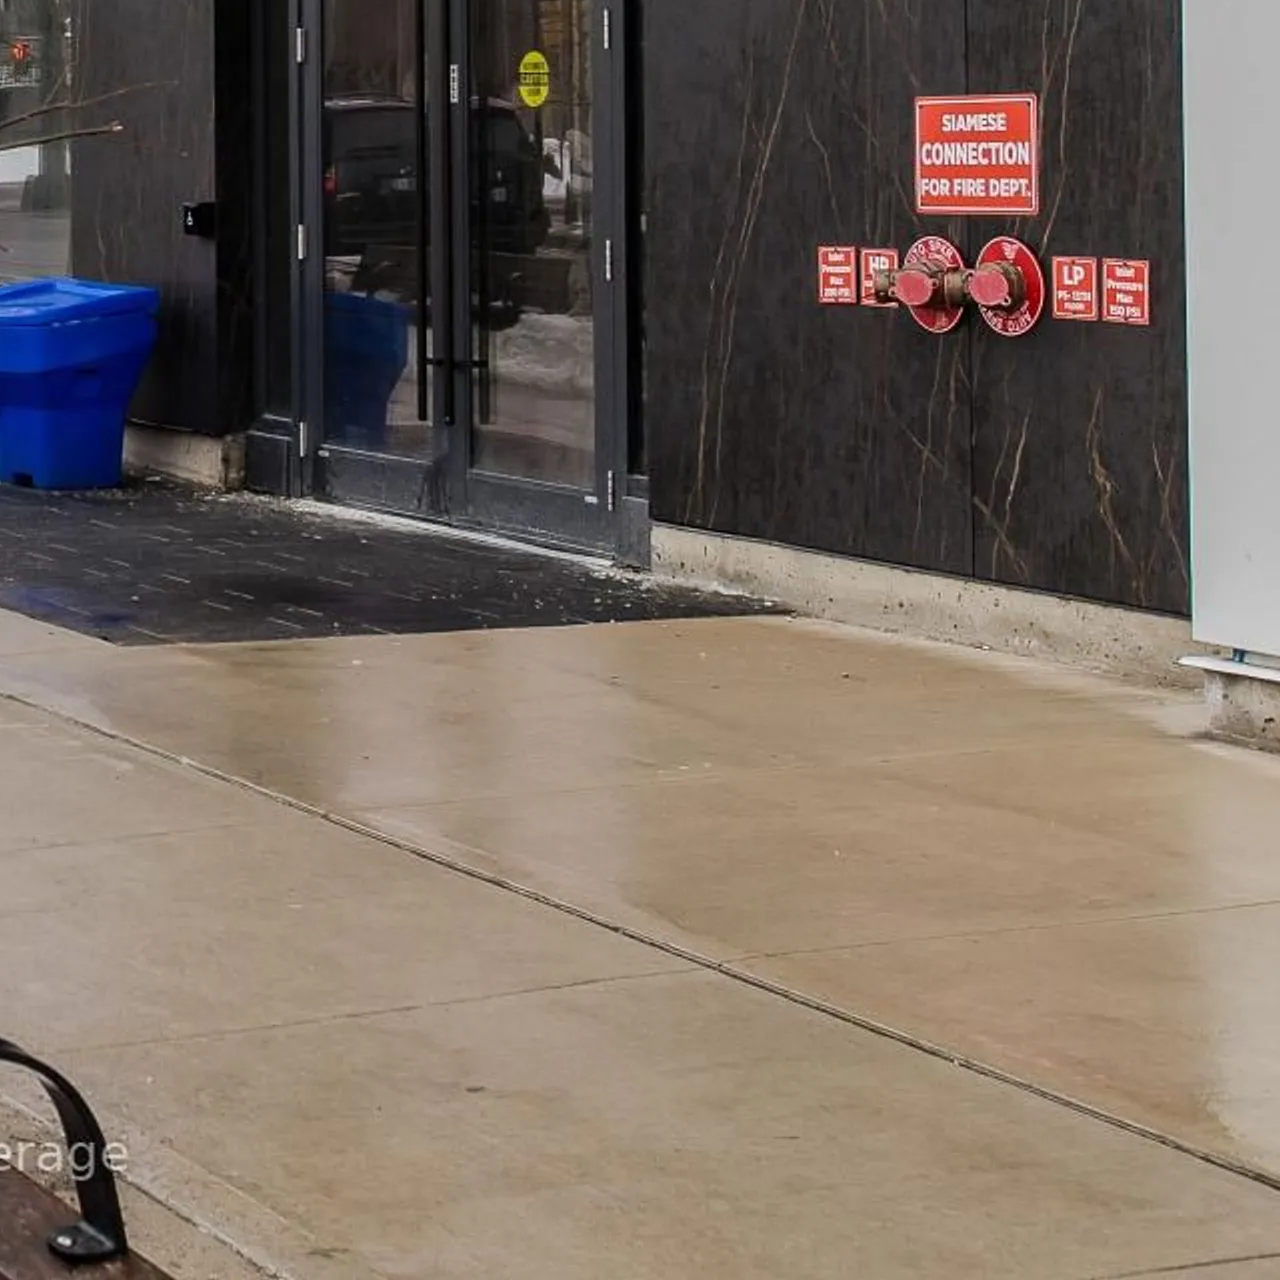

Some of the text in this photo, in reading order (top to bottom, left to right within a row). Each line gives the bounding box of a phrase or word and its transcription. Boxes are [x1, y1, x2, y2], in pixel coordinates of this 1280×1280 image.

[942, 112, 1007, 132] SIAMESE
[921, 141, 1030, 166] CONNECTION
[921, 178, 1032, 198] FOR FIRE DEPT.
[1063, 265, 1085, 286] LP
